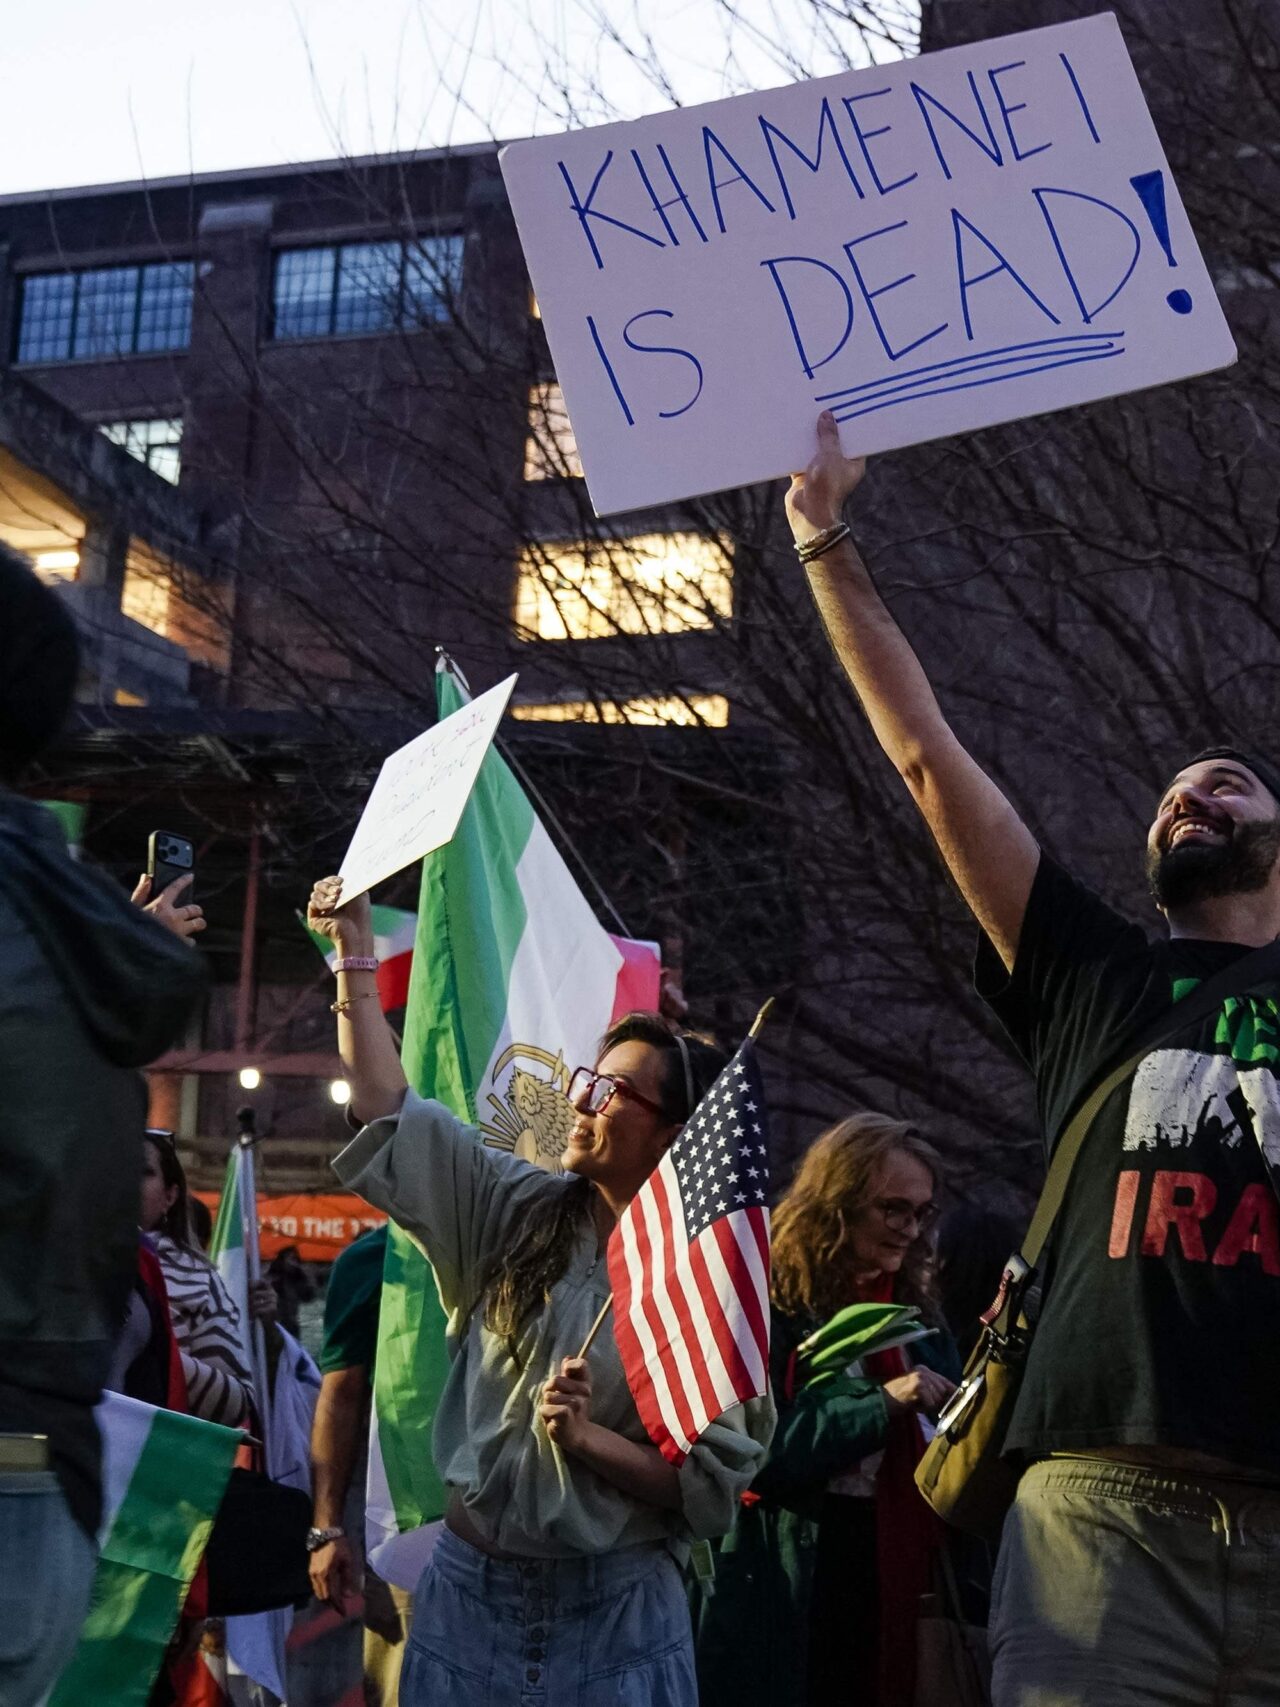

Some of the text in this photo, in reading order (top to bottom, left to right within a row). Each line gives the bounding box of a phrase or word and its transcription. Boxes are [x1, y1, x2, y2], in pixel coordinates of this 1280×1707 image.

[557, 52, 1101, 269] KHAMENEI
[586, 169, 1193, 426] IS DEAD!
[303, 1216, 345, 1239] THE
